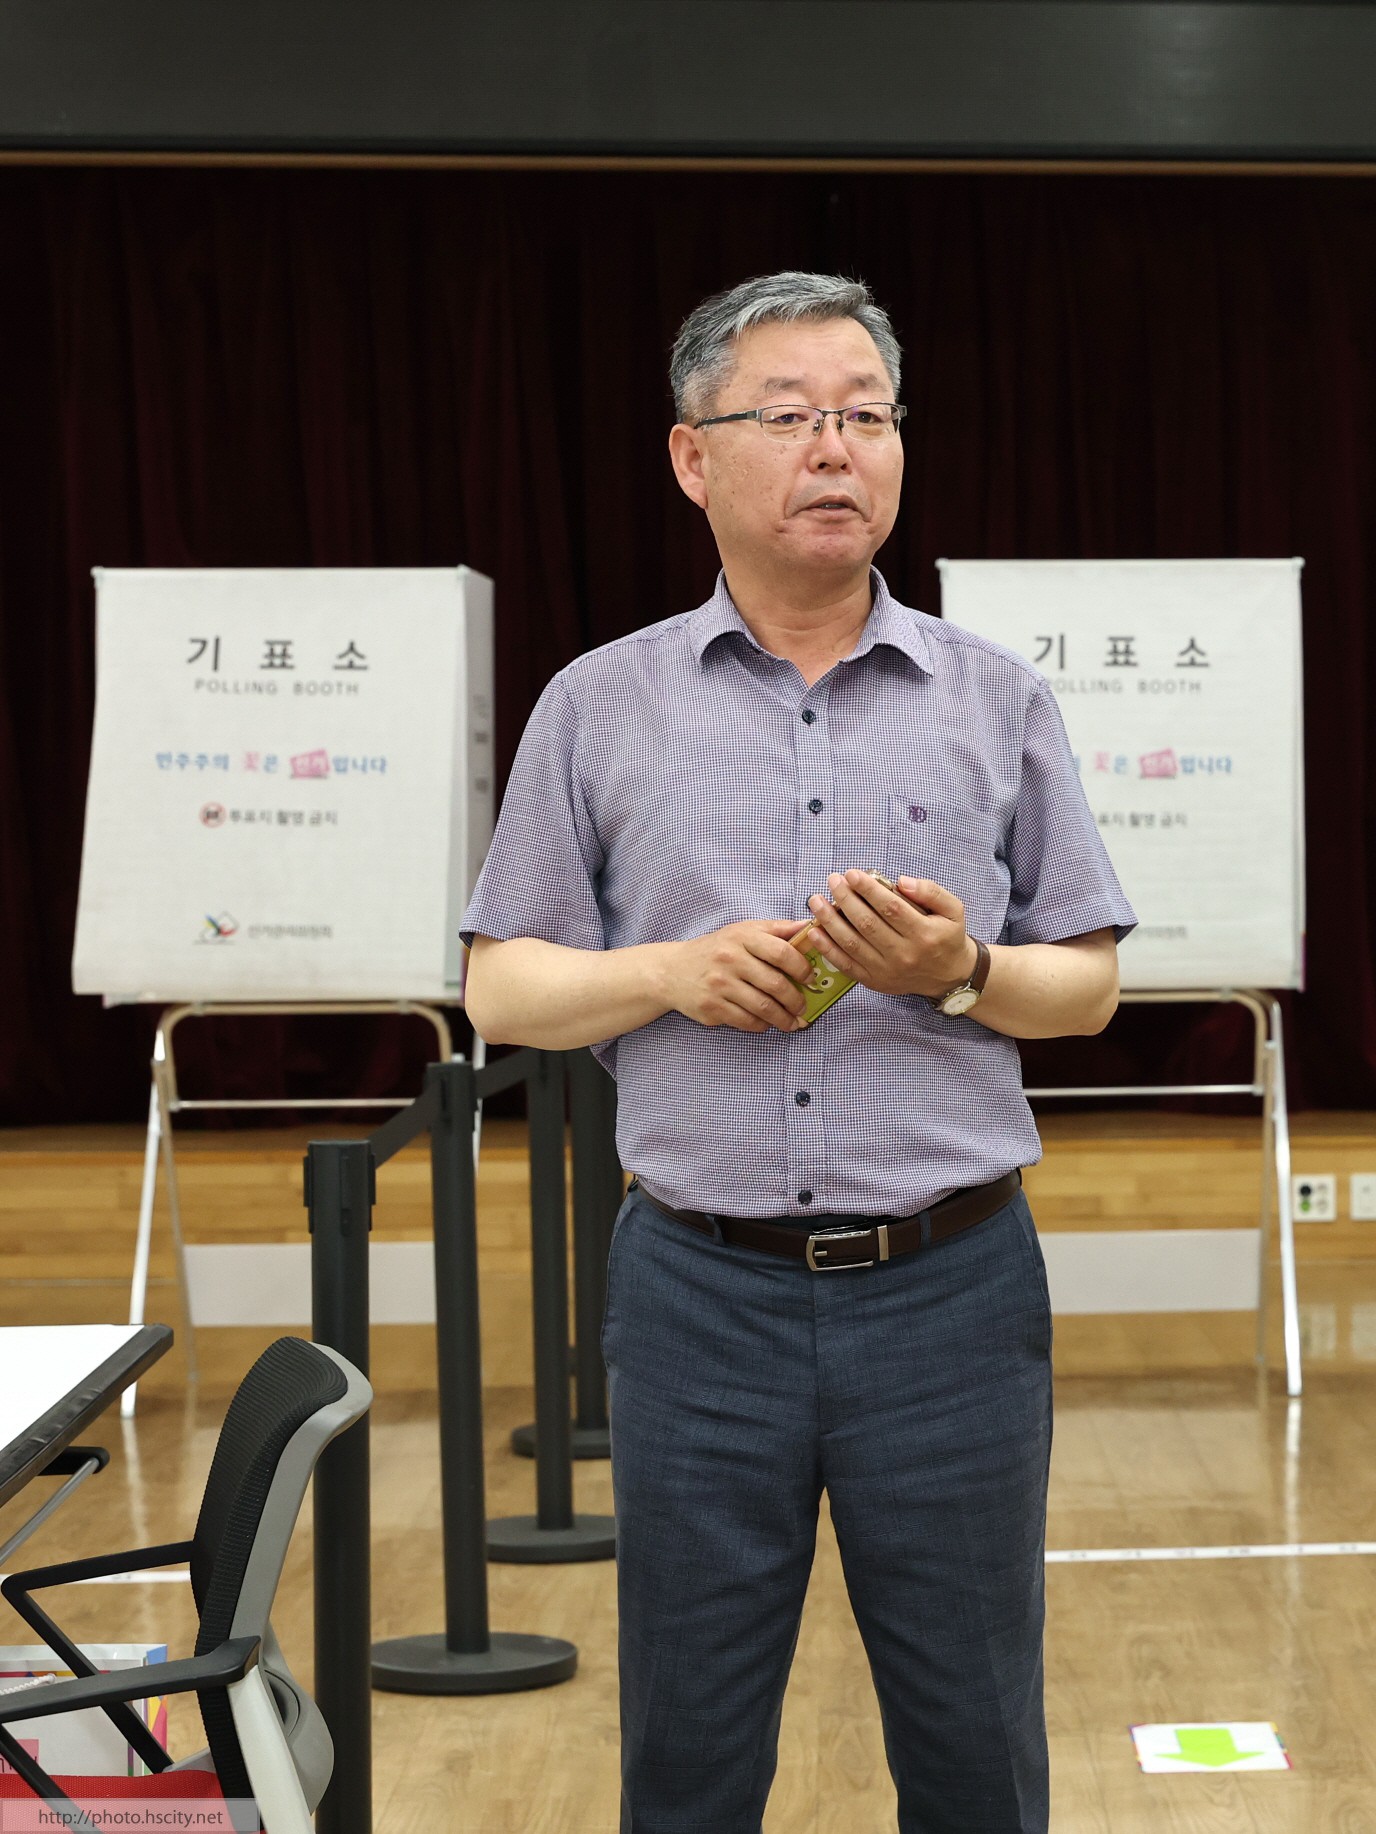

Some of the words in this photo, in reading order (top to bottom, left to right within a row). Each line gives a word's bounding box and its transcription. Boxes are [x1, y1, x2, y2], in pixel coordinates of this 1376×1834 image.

[187, 635, 369, 673] 기표소
[1034, 634, 1211, 670] 기표소
[195, 678, 279, 696] POLLING
[293, 680, 360, 696] BOOTH
[1137, 680, 1202, 694] BOOTH
